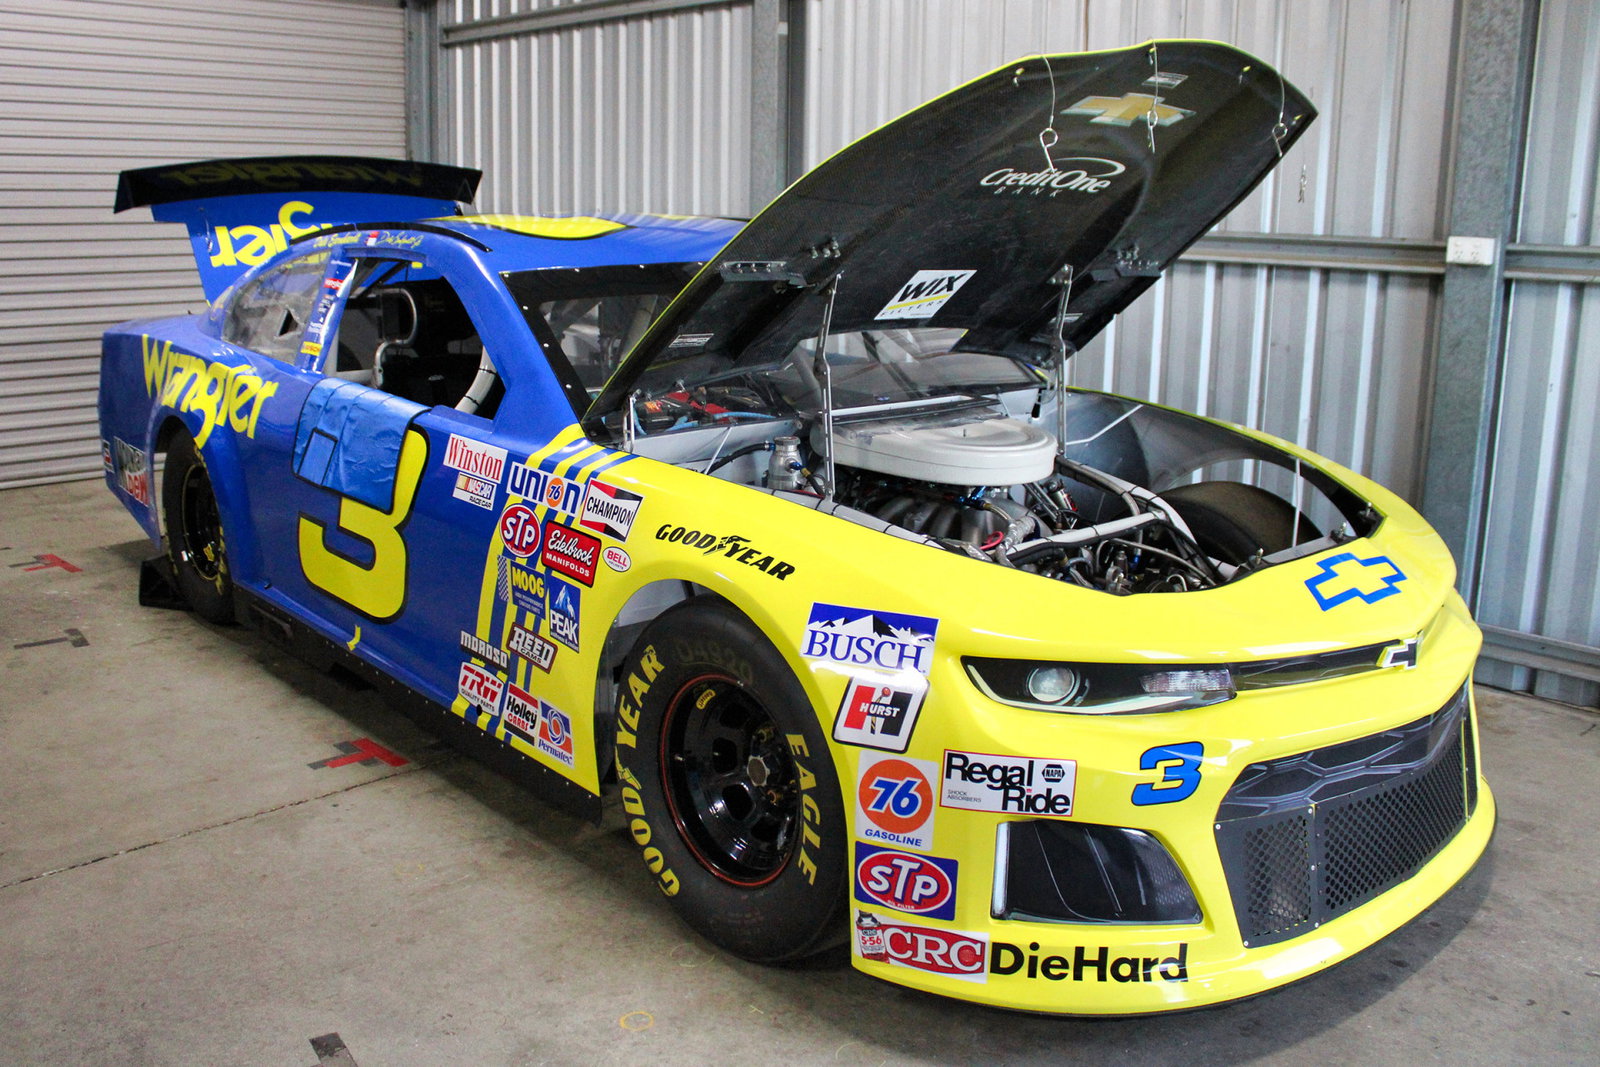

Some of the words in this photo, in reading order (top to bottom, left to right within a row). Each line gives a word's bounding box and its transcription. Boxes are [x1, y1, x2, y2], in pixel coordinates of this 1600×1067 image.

[993, 186, 1062, 197] BANK
[897, 273, 968, 302] WIX
[880, 300, 944, 317] FILTERS
[142, 333, 280, 449] Wrangler
[447, 436, 503, 481] Winston
[468, 477, 493, 500] NASCAR
[548, 484, 561, 500] 76
[297, 422, 430, 625] 3
[503, 510, 536, 548] STP
[586, 496, 635, 527] CHAMPION
[545, 552, 590, 578] MANIFOLDS
[548, 529, 595, 567] Edelbrock
[606, 549, 628, 568] BELL
[512, 566, 545, 598] MOOG
[550, 608, 579, 645] PEAK
[460, 630, 508, 669] MOROSO
[509, 626, 556, 670] REED
[520, 648, 542, 664] CAMS
[803, 629, 926, 673] BUSCH
[460, 664, 503, 704] TRW
[461, 687, 481, 703] QUALITY
[480, 699, 495, 713] PARTS
[506, 695, 538, 730] Holley
[507, 713, 529, 732] CARBS
[859, 702, 900, 718] HURST
[945, 752, 1035, 791] Regal
[1045, 769, 1062, 778] NAPA
[1131, 740, 1205, 807] 3
[785, 733, 821, 886] EAGLE
[867, 776, 923, 819] 76
[1001, 785, 1071, 815] Ride
[864, 828, 923, 847] GASOLINE
[867, 858, 939, 903] STP
[897, 902, 916, 910] FILTER
[883, 927, 983, 972] CRC
[989, 941, 1189, 983] DieHard
